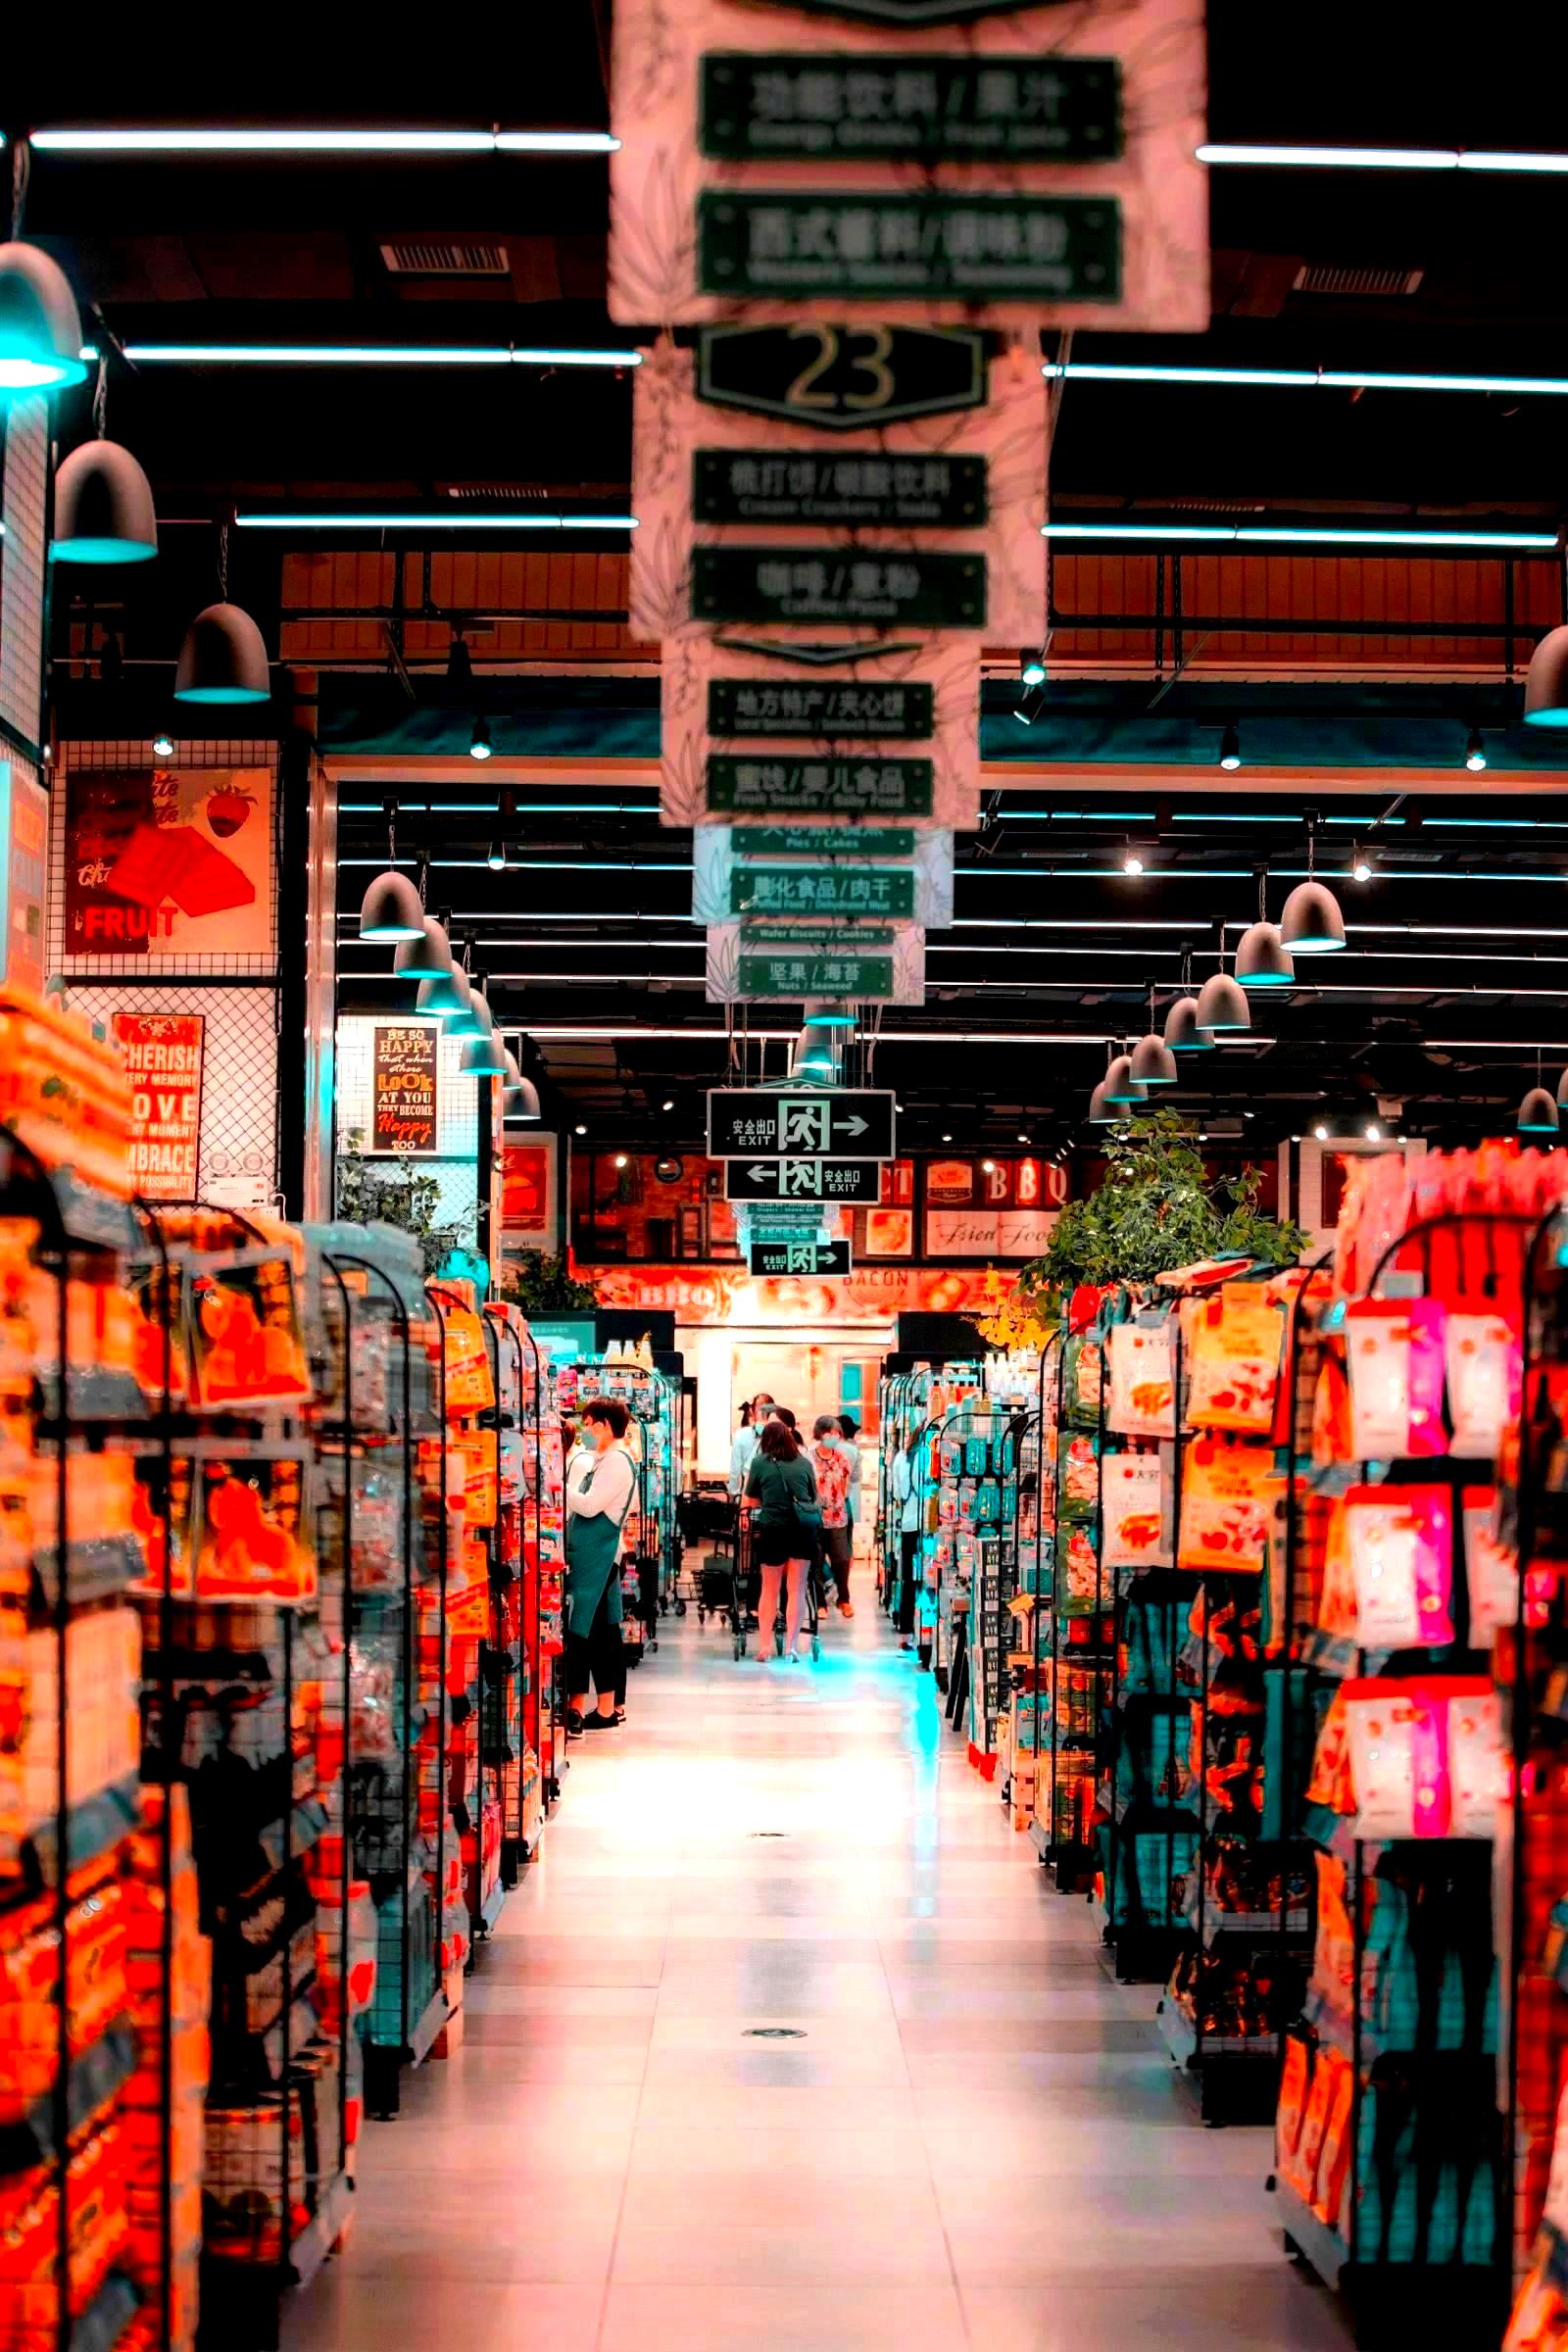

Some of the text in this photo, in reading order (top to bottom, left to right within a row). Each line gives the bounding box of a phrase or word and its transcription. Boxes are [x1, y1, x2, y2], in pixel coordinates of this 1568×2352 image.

[786, 323, 896, 409] 23
[786, 838, 809, 848] Pies
[823, 838, 858, 849] Cakes
[85, 906, 178, 938] FRUIT
[760, 929, 787, 939] Wafer
[789, 929, 826, 939] Biscuits
[837, 929, 874, 939] Cookies
[769, 962, 807, 981] 坚果
[824, 962, 860, 981] 海苔
[811, 981, 853, 990] Seaweed
[387, 1030, 425, 1041] BE SO
[379, 1041, 434, 1053] HAPPY
[378, 1092, 431, 1103] AT YOU
[133, 1093, 196, 1121] OVE
[400, 1104, 433, 1115] BECOME
[149, 1123, 195, 1137] MOMENT
[378, 1113, 432, 1143] Happy
[732, 1119, 775, 1135] 安全出口
[392, 1141, 416, 1150] TOO
[738, 1136, 771, 1146] EXIT
[126, 1144, 195, 1173] MBRACE
[824, 1169, 860, 1183] 安全出口
[990, 1166, 1067, 1204] BBQ
[762, 1254, 786, 1264] 安全出口
[843, 1270, 907, 1287] BACON
[640, 1285, 714, 1306] BBQ
